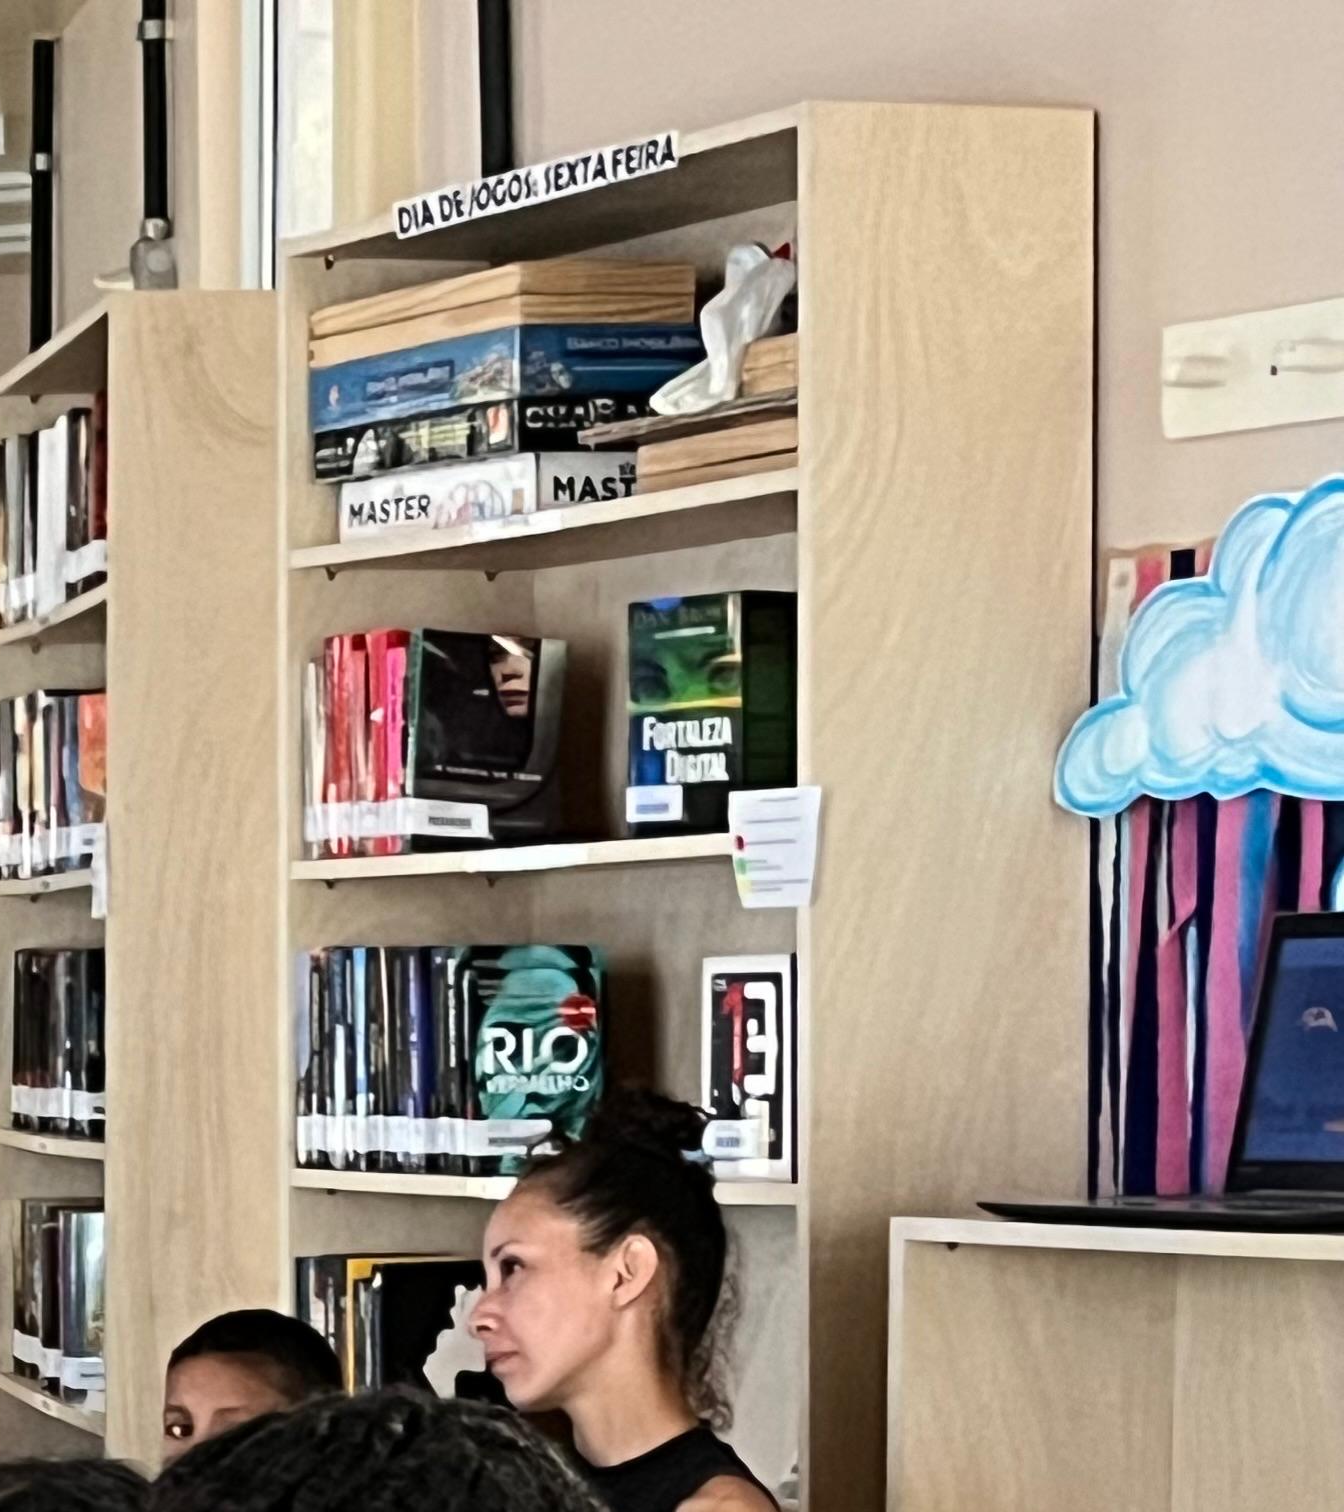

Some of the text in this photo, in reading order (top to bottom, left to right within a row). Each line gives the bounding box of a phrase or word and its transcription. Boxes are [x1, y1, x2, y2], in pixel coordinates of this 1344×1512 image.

[398, 202, 434, 234] DIA
[439, 189, 465, 222] DE
[544, 155, 607, 194] SEXTA
[611, 135, 676, 179] FEIRA
[553, 476, 637, 502] MAST
[348, 494, 431, 528] MASTER
[483, 1027, 589, 1074] RIO
